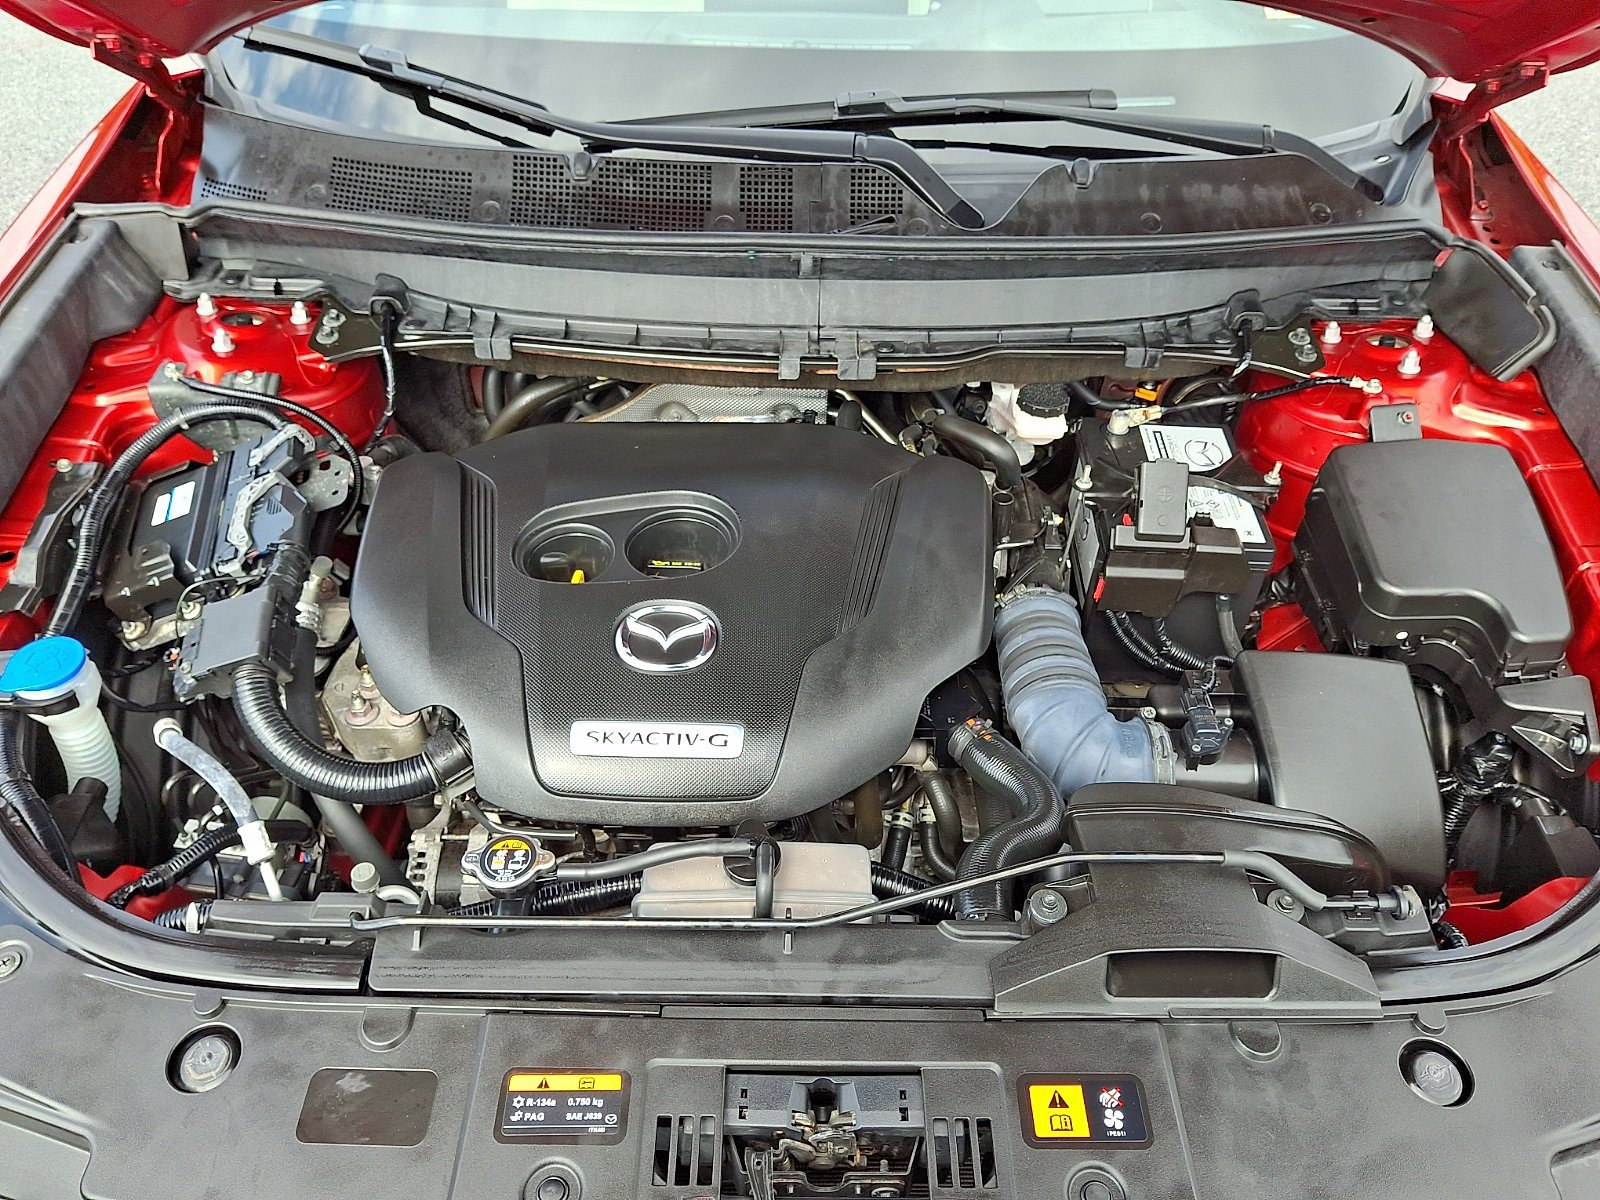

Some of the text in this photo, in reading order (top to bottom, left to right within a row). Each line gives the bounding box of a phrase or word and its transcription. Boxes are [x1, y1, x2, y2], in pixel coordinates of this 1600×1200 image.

[586, 731, 729, 747] SKYACTIV-G
[526, 1098, 604, 1108] R-134a 0.750 kg
[524, 1113, 545, 1122] PAG
[566, 1112, 583, 1121] SAE
